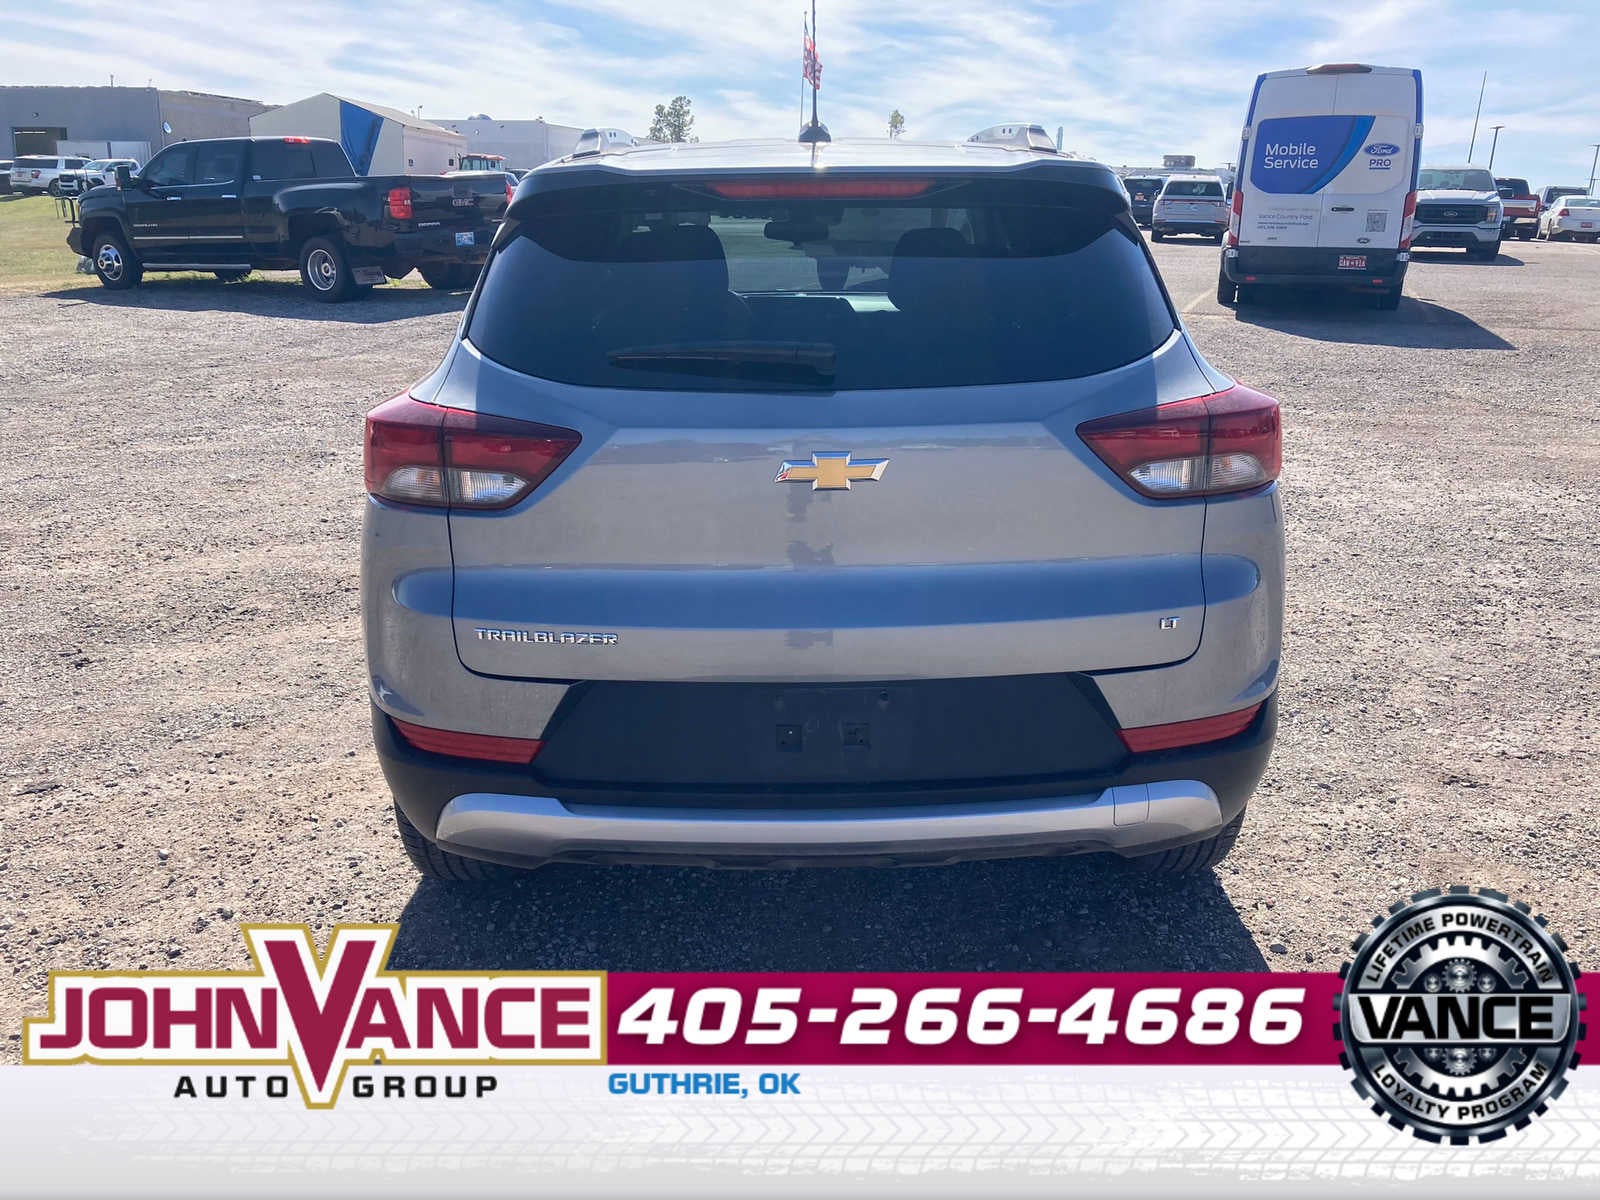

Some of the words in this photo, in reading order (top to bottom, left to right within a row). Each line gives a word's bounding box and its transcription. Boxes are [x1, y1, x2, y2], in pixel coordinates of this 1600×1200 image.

[1265, 143, 1316, 156] Mobile
[1370, 144, 1394, 154] Ford
[1263, 157, 1319, 169] Service
[1369, 159, 1392, 167] PRO
[1160, 616, 1181, 630] LT
[474, 627, 619, 645] TRAILBLAZER
